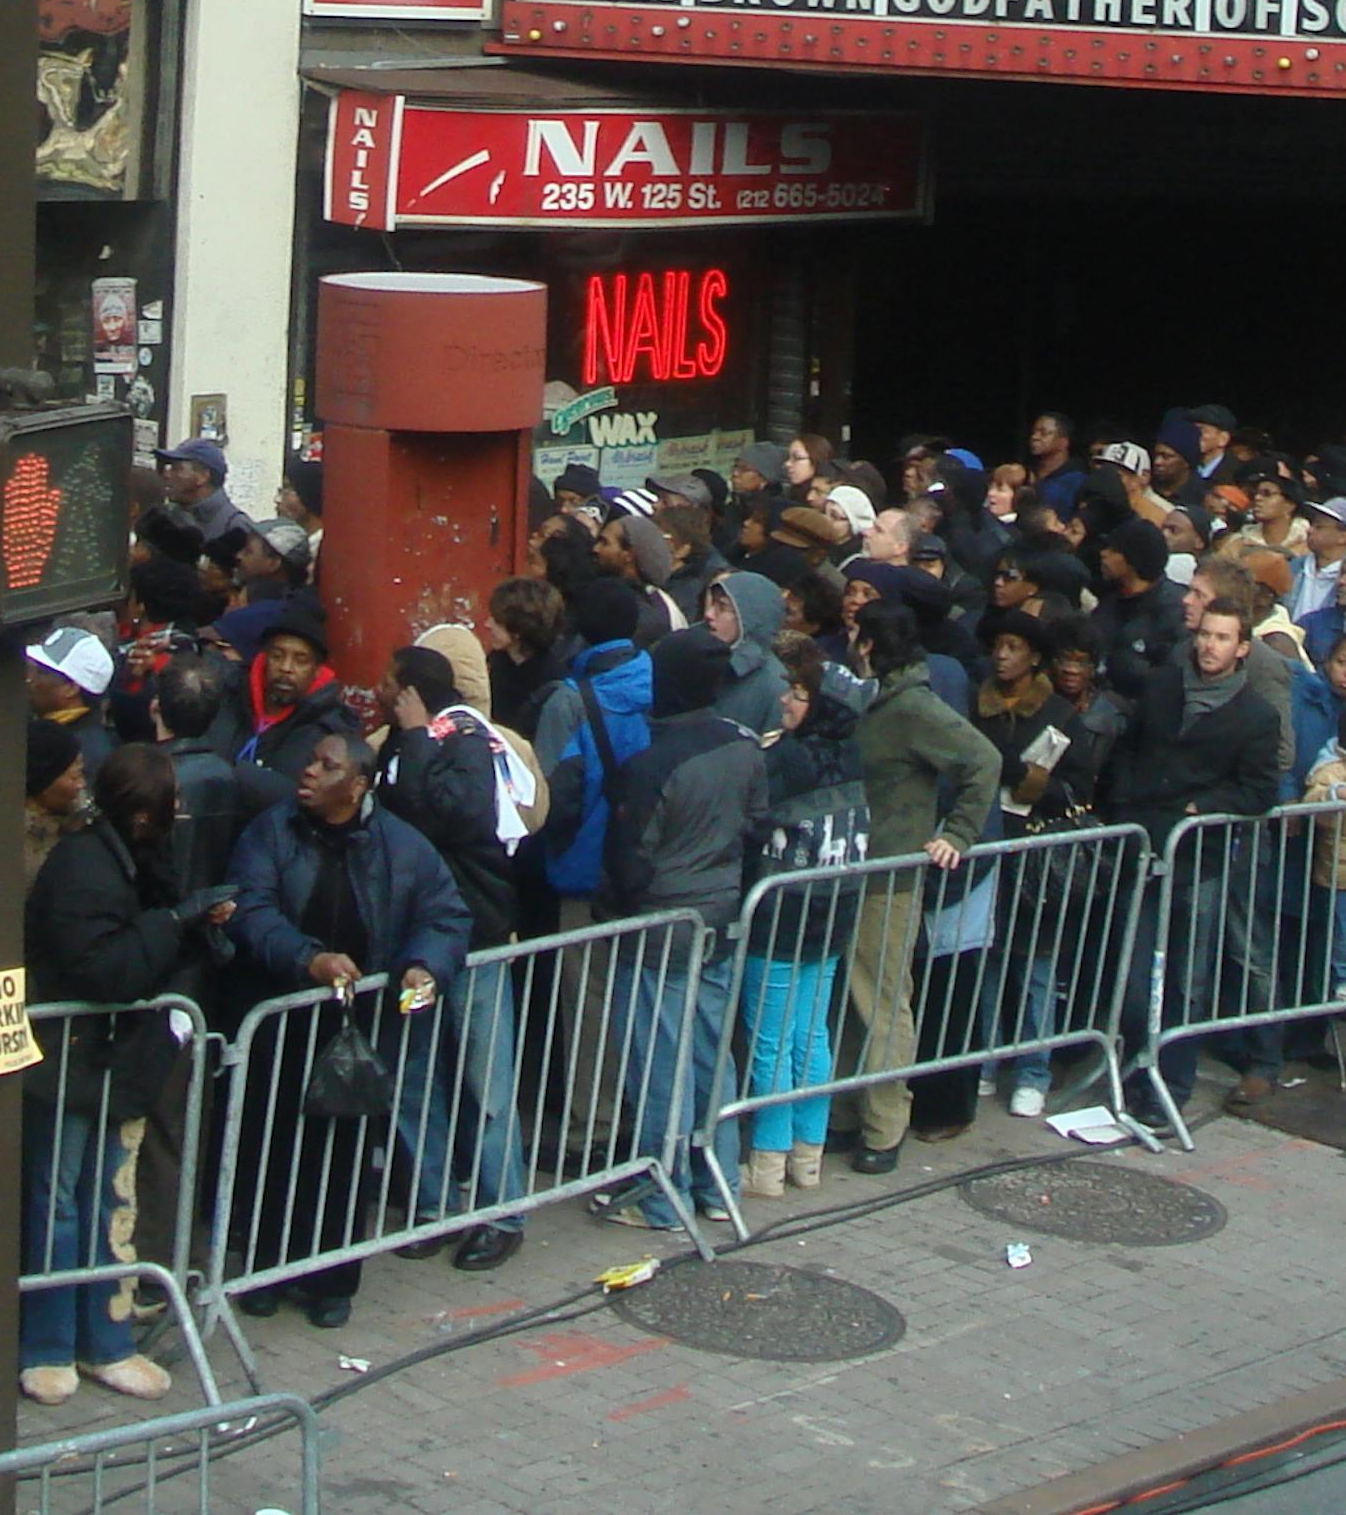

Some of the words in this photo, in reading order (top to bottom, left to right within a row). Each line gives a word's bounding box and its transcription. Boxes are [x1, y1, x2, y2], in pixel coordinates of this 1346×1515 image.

[349, 107, 378, 211] NAILS
[524, 119, 833, 177] NAILS
[541, 183, 595, 211] 235
[641, 183, 682, 210] 125
[687, 182, 722, 209] St.
[584, 269, 727, 385] NAILS
[590, 412, 658, 448] WAX
